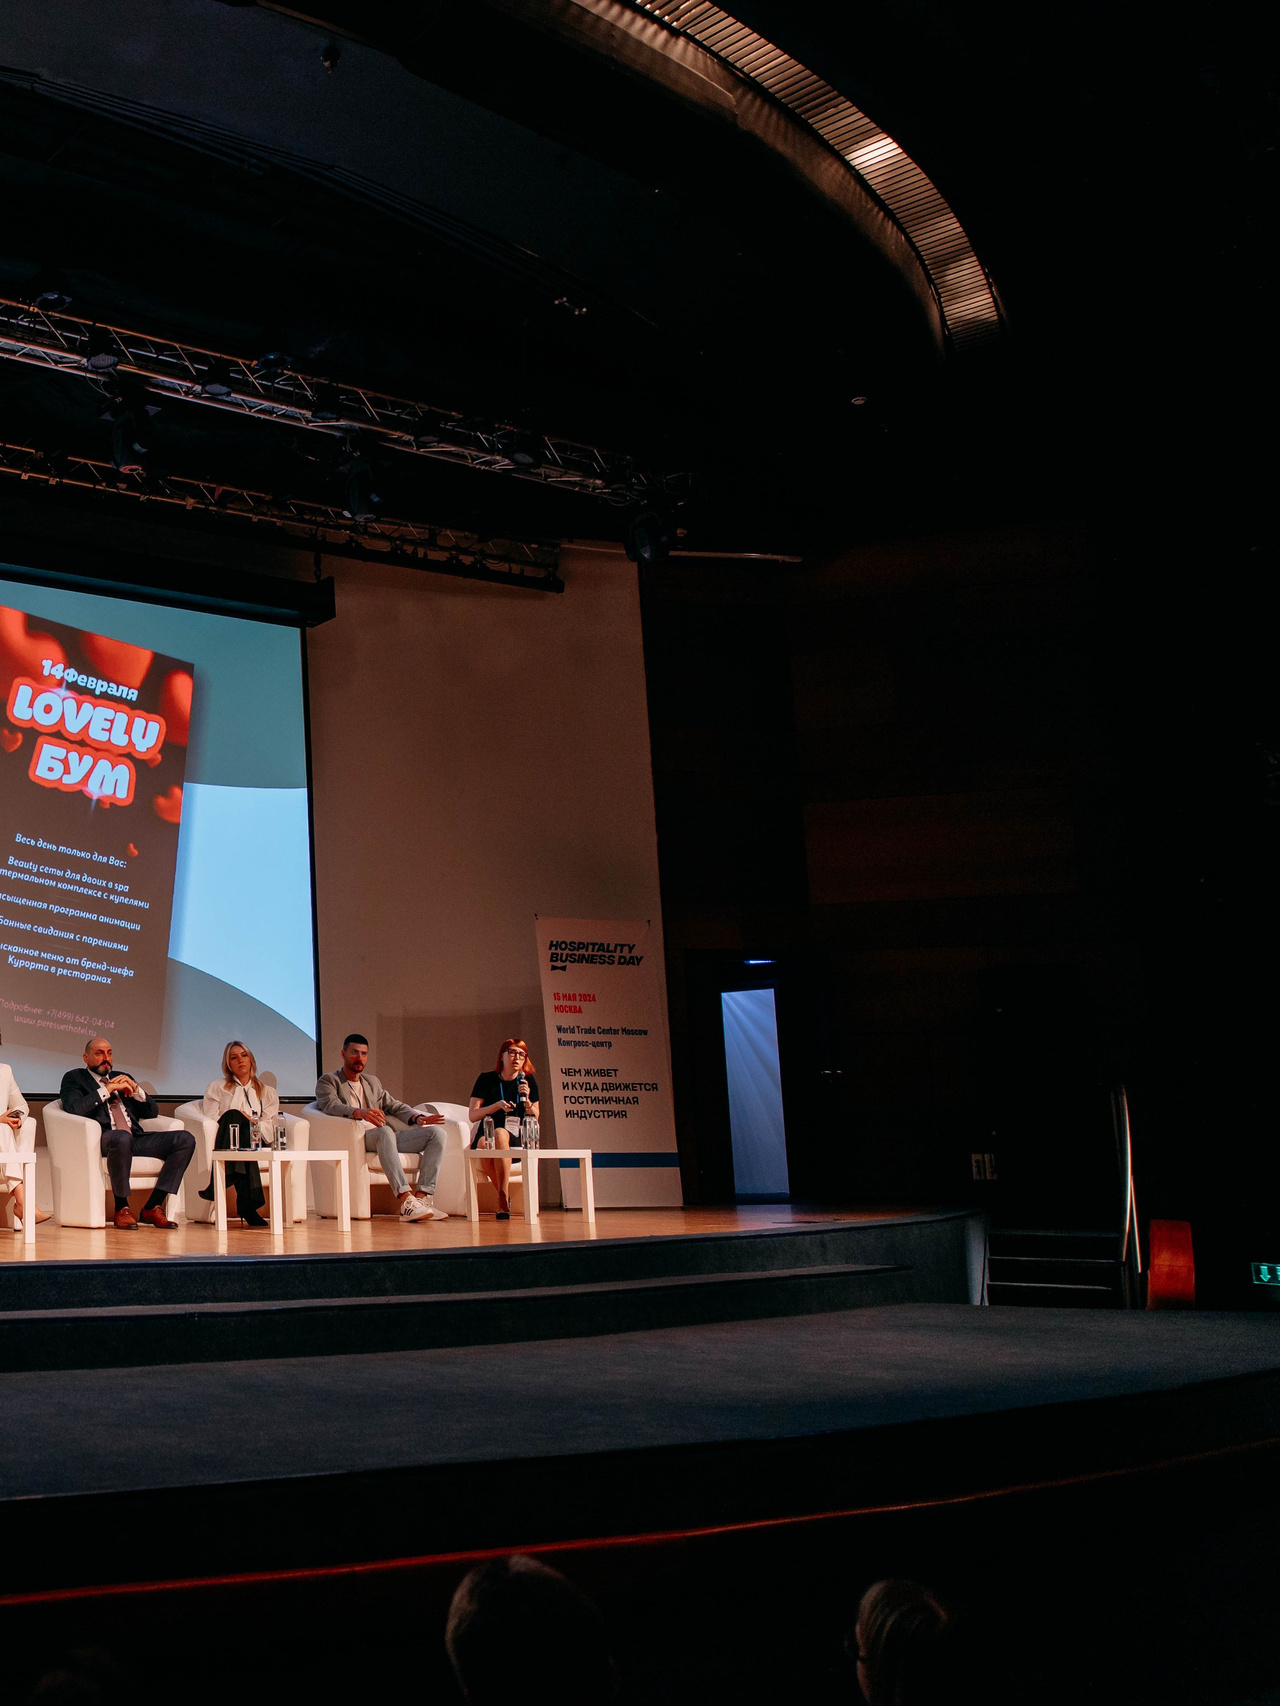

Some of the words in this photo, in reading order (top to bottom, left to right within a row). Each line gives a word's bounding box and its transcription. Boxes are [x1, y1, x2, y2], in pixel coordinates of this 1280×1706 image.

[12, 685, 159, 752] LOVELY
[35, 743, 129, 798] БУМ
[15, 833, 35, 845] Весь
[36, 838, 56, 851] день
[58, 845, 90, 859] только
[92, 851, 107, 863] для
[108, 855, 126, 868] Вас:
[7, 855, 38, 872] Beauty
[39, 865, 63, 876] сеты
[64, 869, 80, 880] для
[81, 872, 106, 886] двоих
[114, 883, 129, 891] spa
[57, 881, 102, 897] комплексе
[109, 894, 149, 908] купелями
[48, 904, 97, 920] программа
[98, 915, 140, 930] анимации
[32, 925, 74, 939] свидания
[81, 935, 128, 951] парениями
[548, 940, 636, 954] HOSPITALITY
[40, 951, 64, 962] меню
[65, 956, 79, 965] от
[80, 957, 134, 977] бренд-шефа
[549, 952, 615, 965] BUSINESS
[617, 955, 643, 966] DAY
[7, 954, 49, 971] Курорта
[56, 967, 111, 984] ресторанах
[553, 992, 560, 1001] 15
[561, 993, 577, 1001] МАЯ
[578, 993, 596, 1002] 2024
[554, 1004, 582, 1014] МОСКВА
[556, 1024, 575, 1034] World
[576, 1025, 596, 1034] Trade
[597, 1026, 620, 1035] Center
[621, 1027, 648, 1035] Moscow
[557, 1038, 612, 1049] Конгресс-центр
[560, 1067, 581, 1076] ЧЕМ
[583, 1068, 618, 1077] ЖИВЕТ
[562, 1081, 569, 1090] И
[570, 1081, 599, 1092] КУДА
[601, 1082, 658, 1092] ДВИЖЕТСЯ
[563, 1095, 639, 1105] ГОСТИНИЧНАЯ
[565, 1109, 627, 1119] ИНДУСТРИЯ
